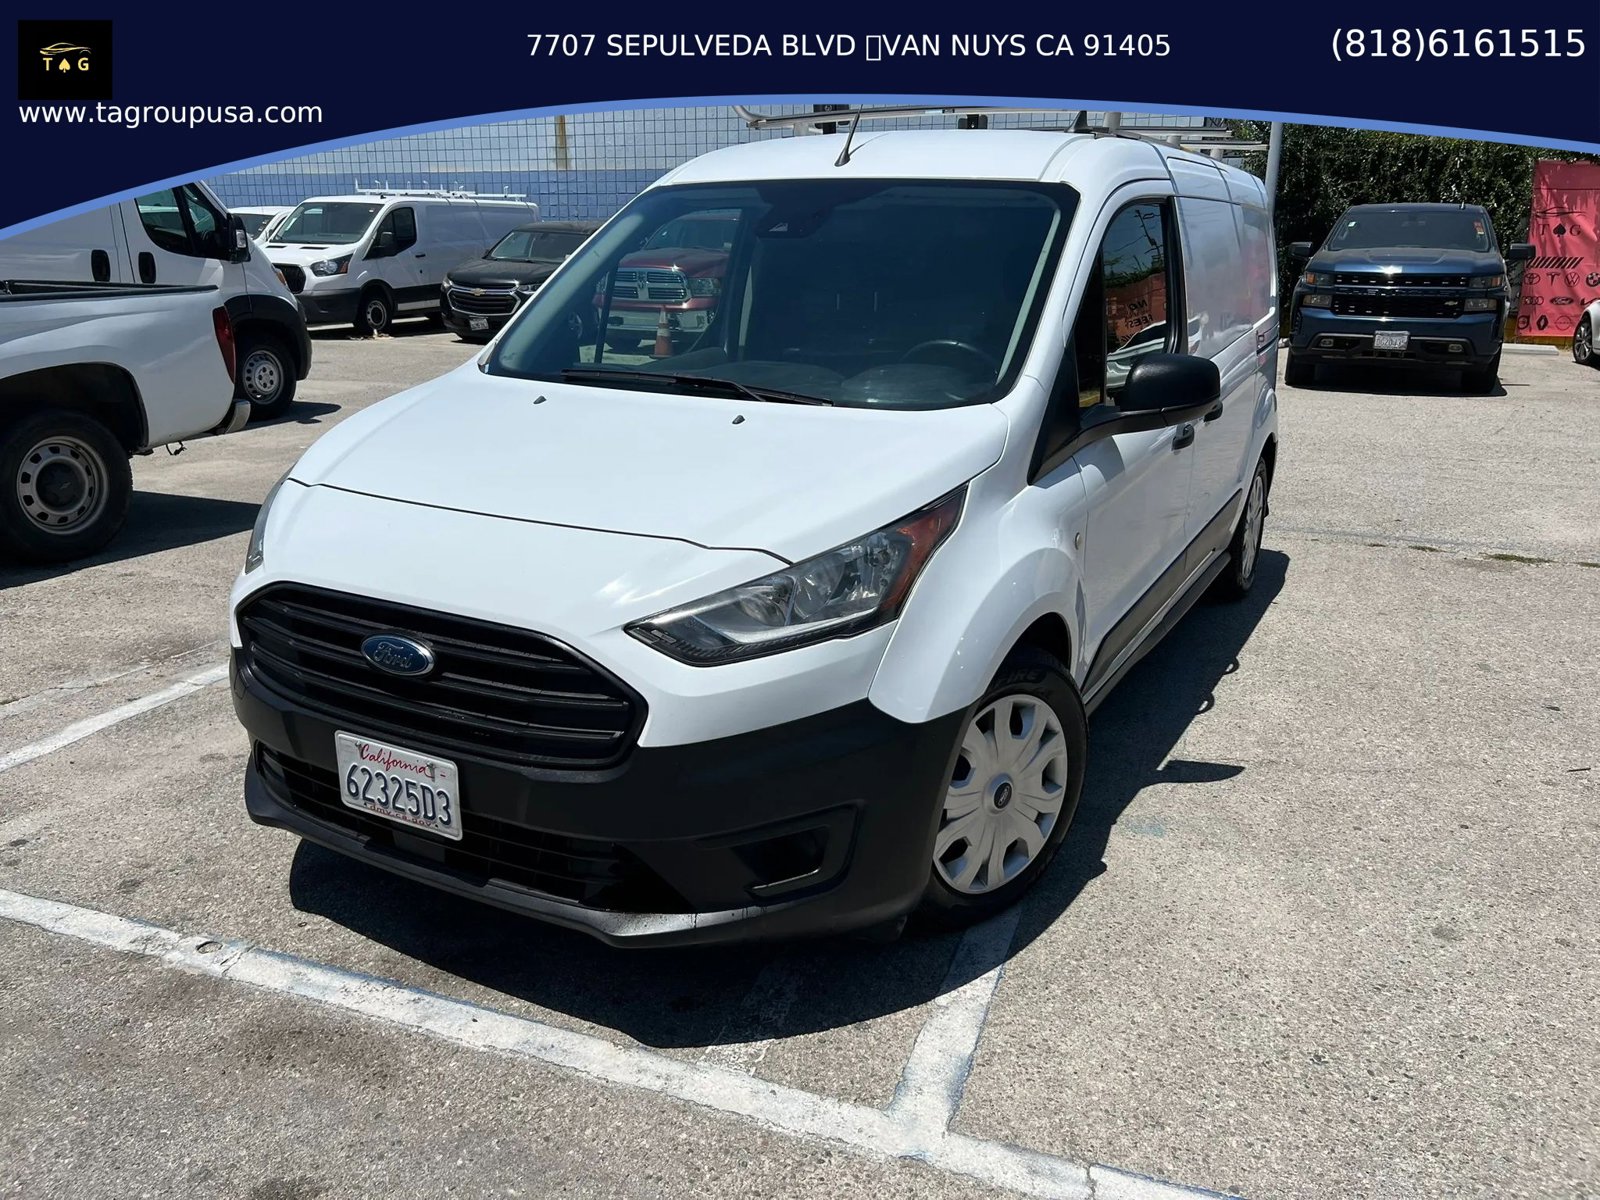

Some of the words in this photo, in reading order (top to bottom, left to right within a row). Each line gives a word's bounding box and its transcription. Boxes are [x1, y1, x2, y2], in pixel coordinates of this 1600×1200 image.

[373, 641, 413, 669] Ford
[360, 743, 435, 779] California
[345, 763, 452, 827] 62325D3
[369, 803, 432, 828] dmv.ca.gov
